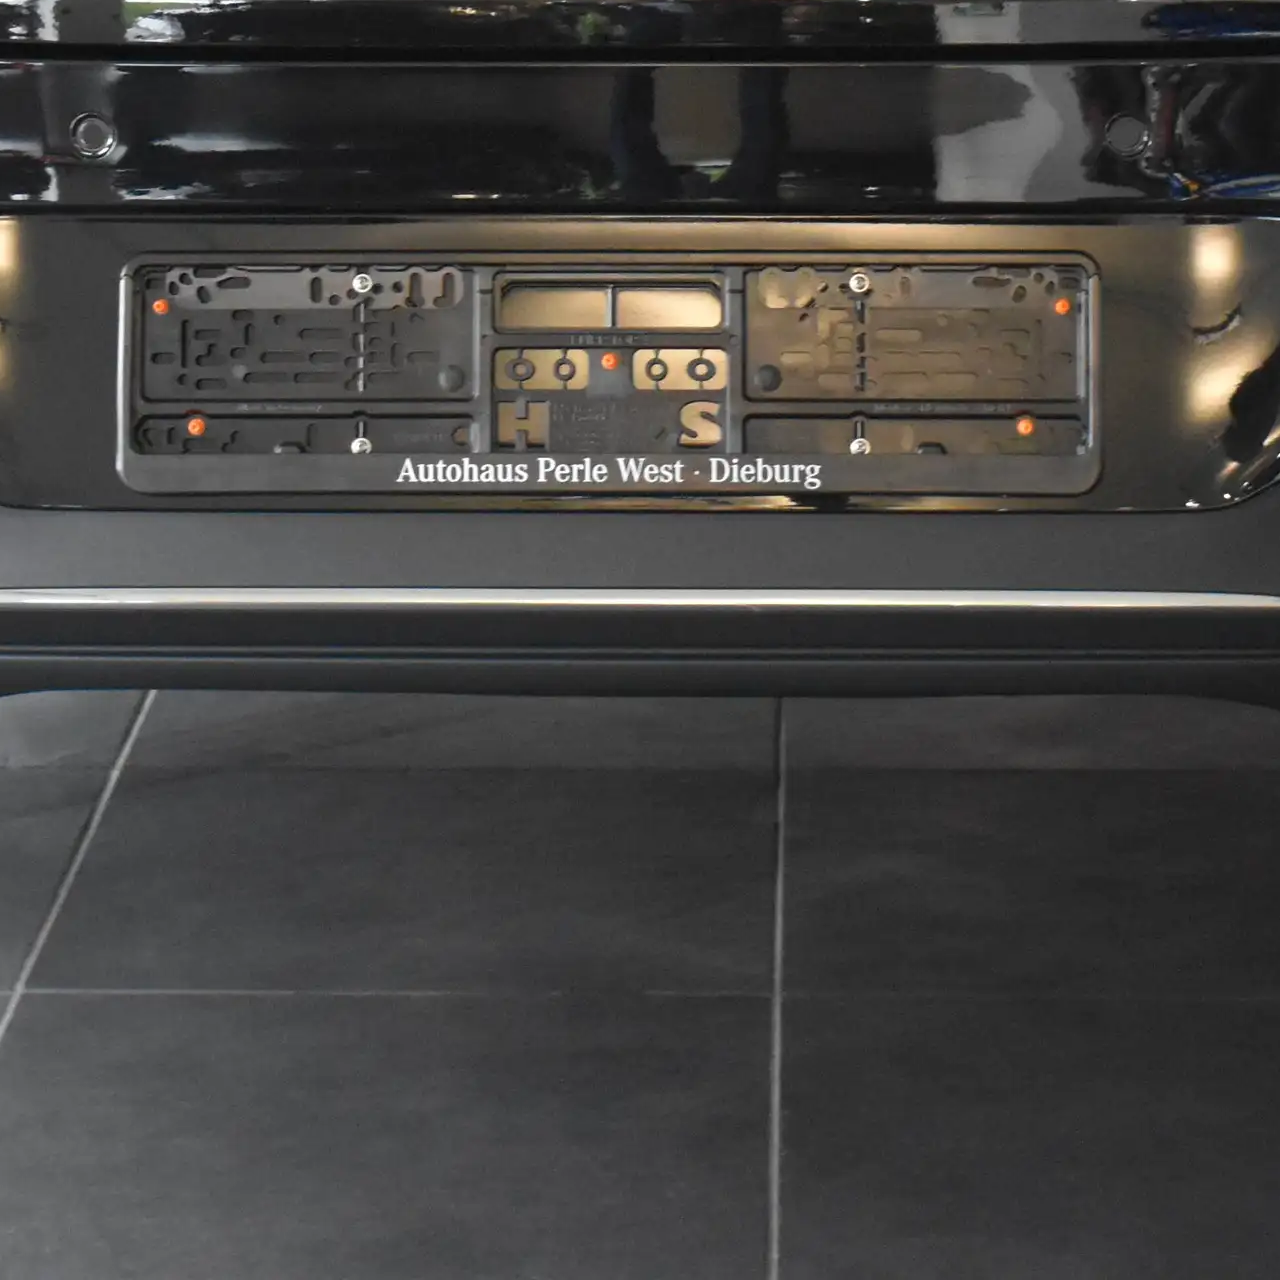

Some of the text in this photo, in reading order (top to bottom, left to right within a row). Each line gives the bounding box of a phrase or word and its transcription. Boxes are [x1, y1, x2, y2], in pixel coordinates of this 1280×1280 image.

[678, 401, 723, 447] S
[396, 457, 822, 489] Autohaus Perle West Dieburg
